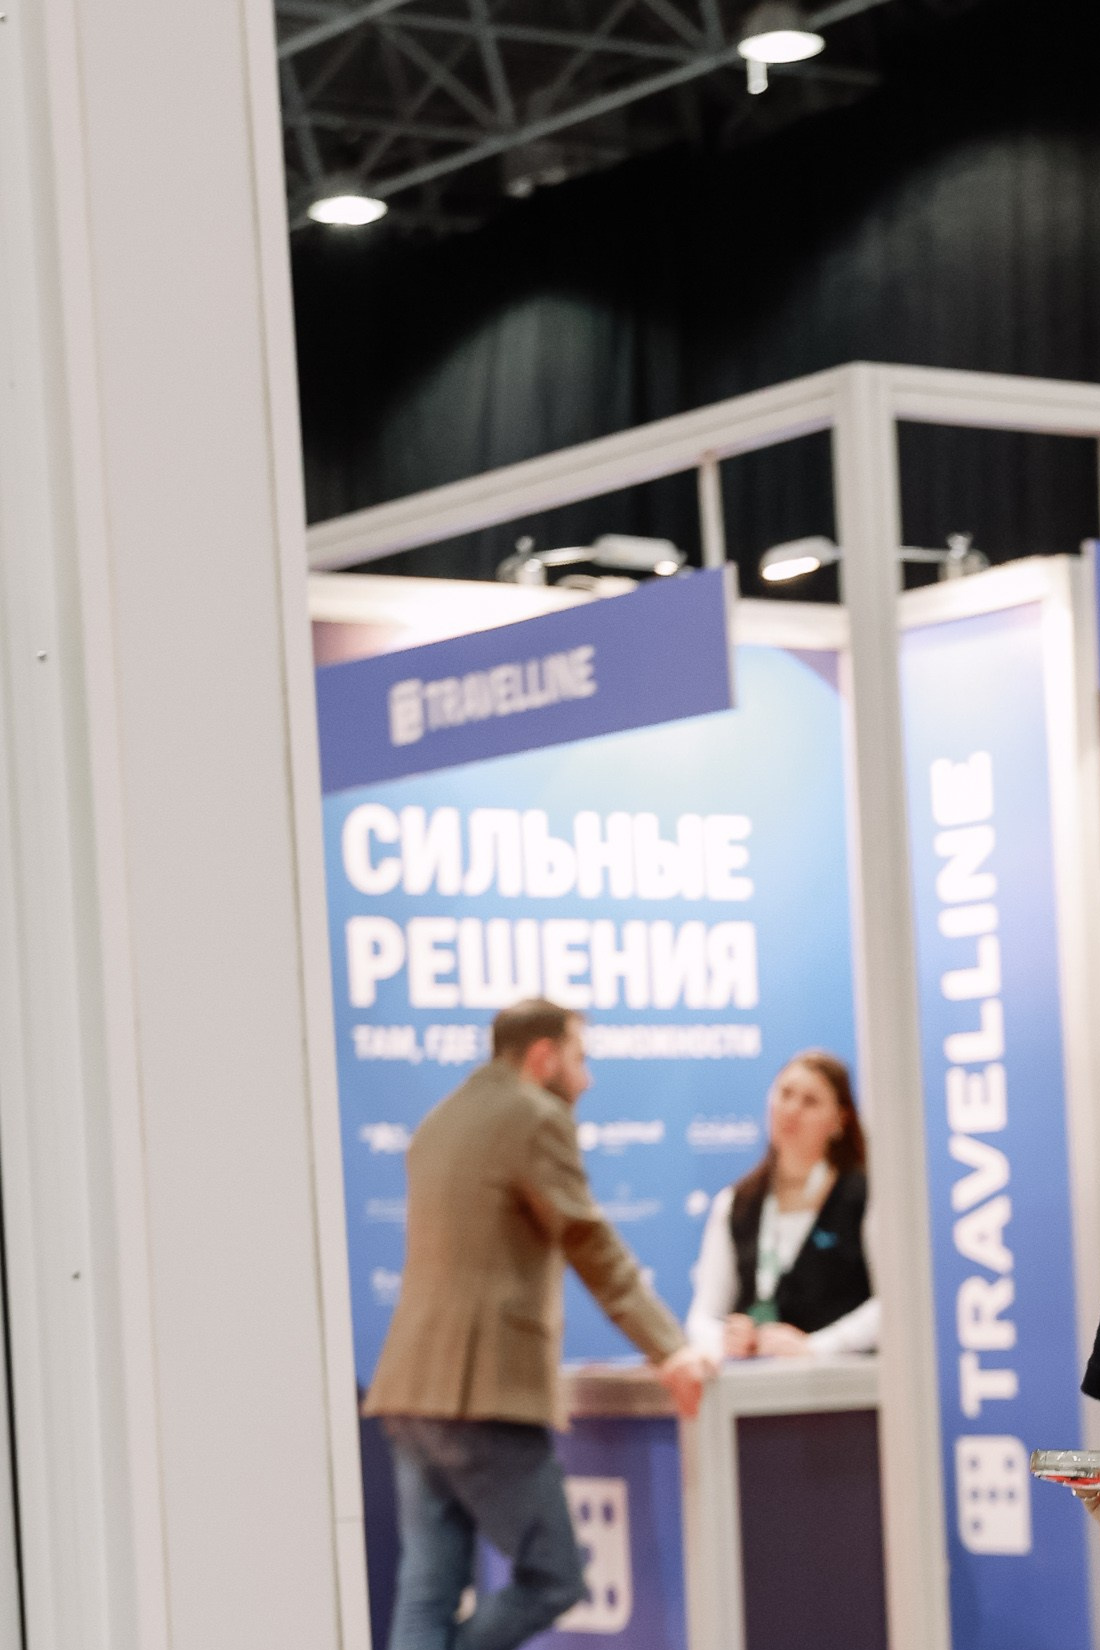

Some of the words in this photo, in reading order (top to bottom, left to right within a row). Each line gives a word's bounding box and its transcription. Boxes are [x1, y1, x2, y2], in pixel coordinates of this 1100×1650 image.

[424, 645, 597, 730] TRAVELLINE
[341, 802, 754, 900] СИЛЬНЫЕ
[345, 915, 759, 1010] РЕШЕНИЯ
[930, 750, 1019, 1420] TRAVELLINE
